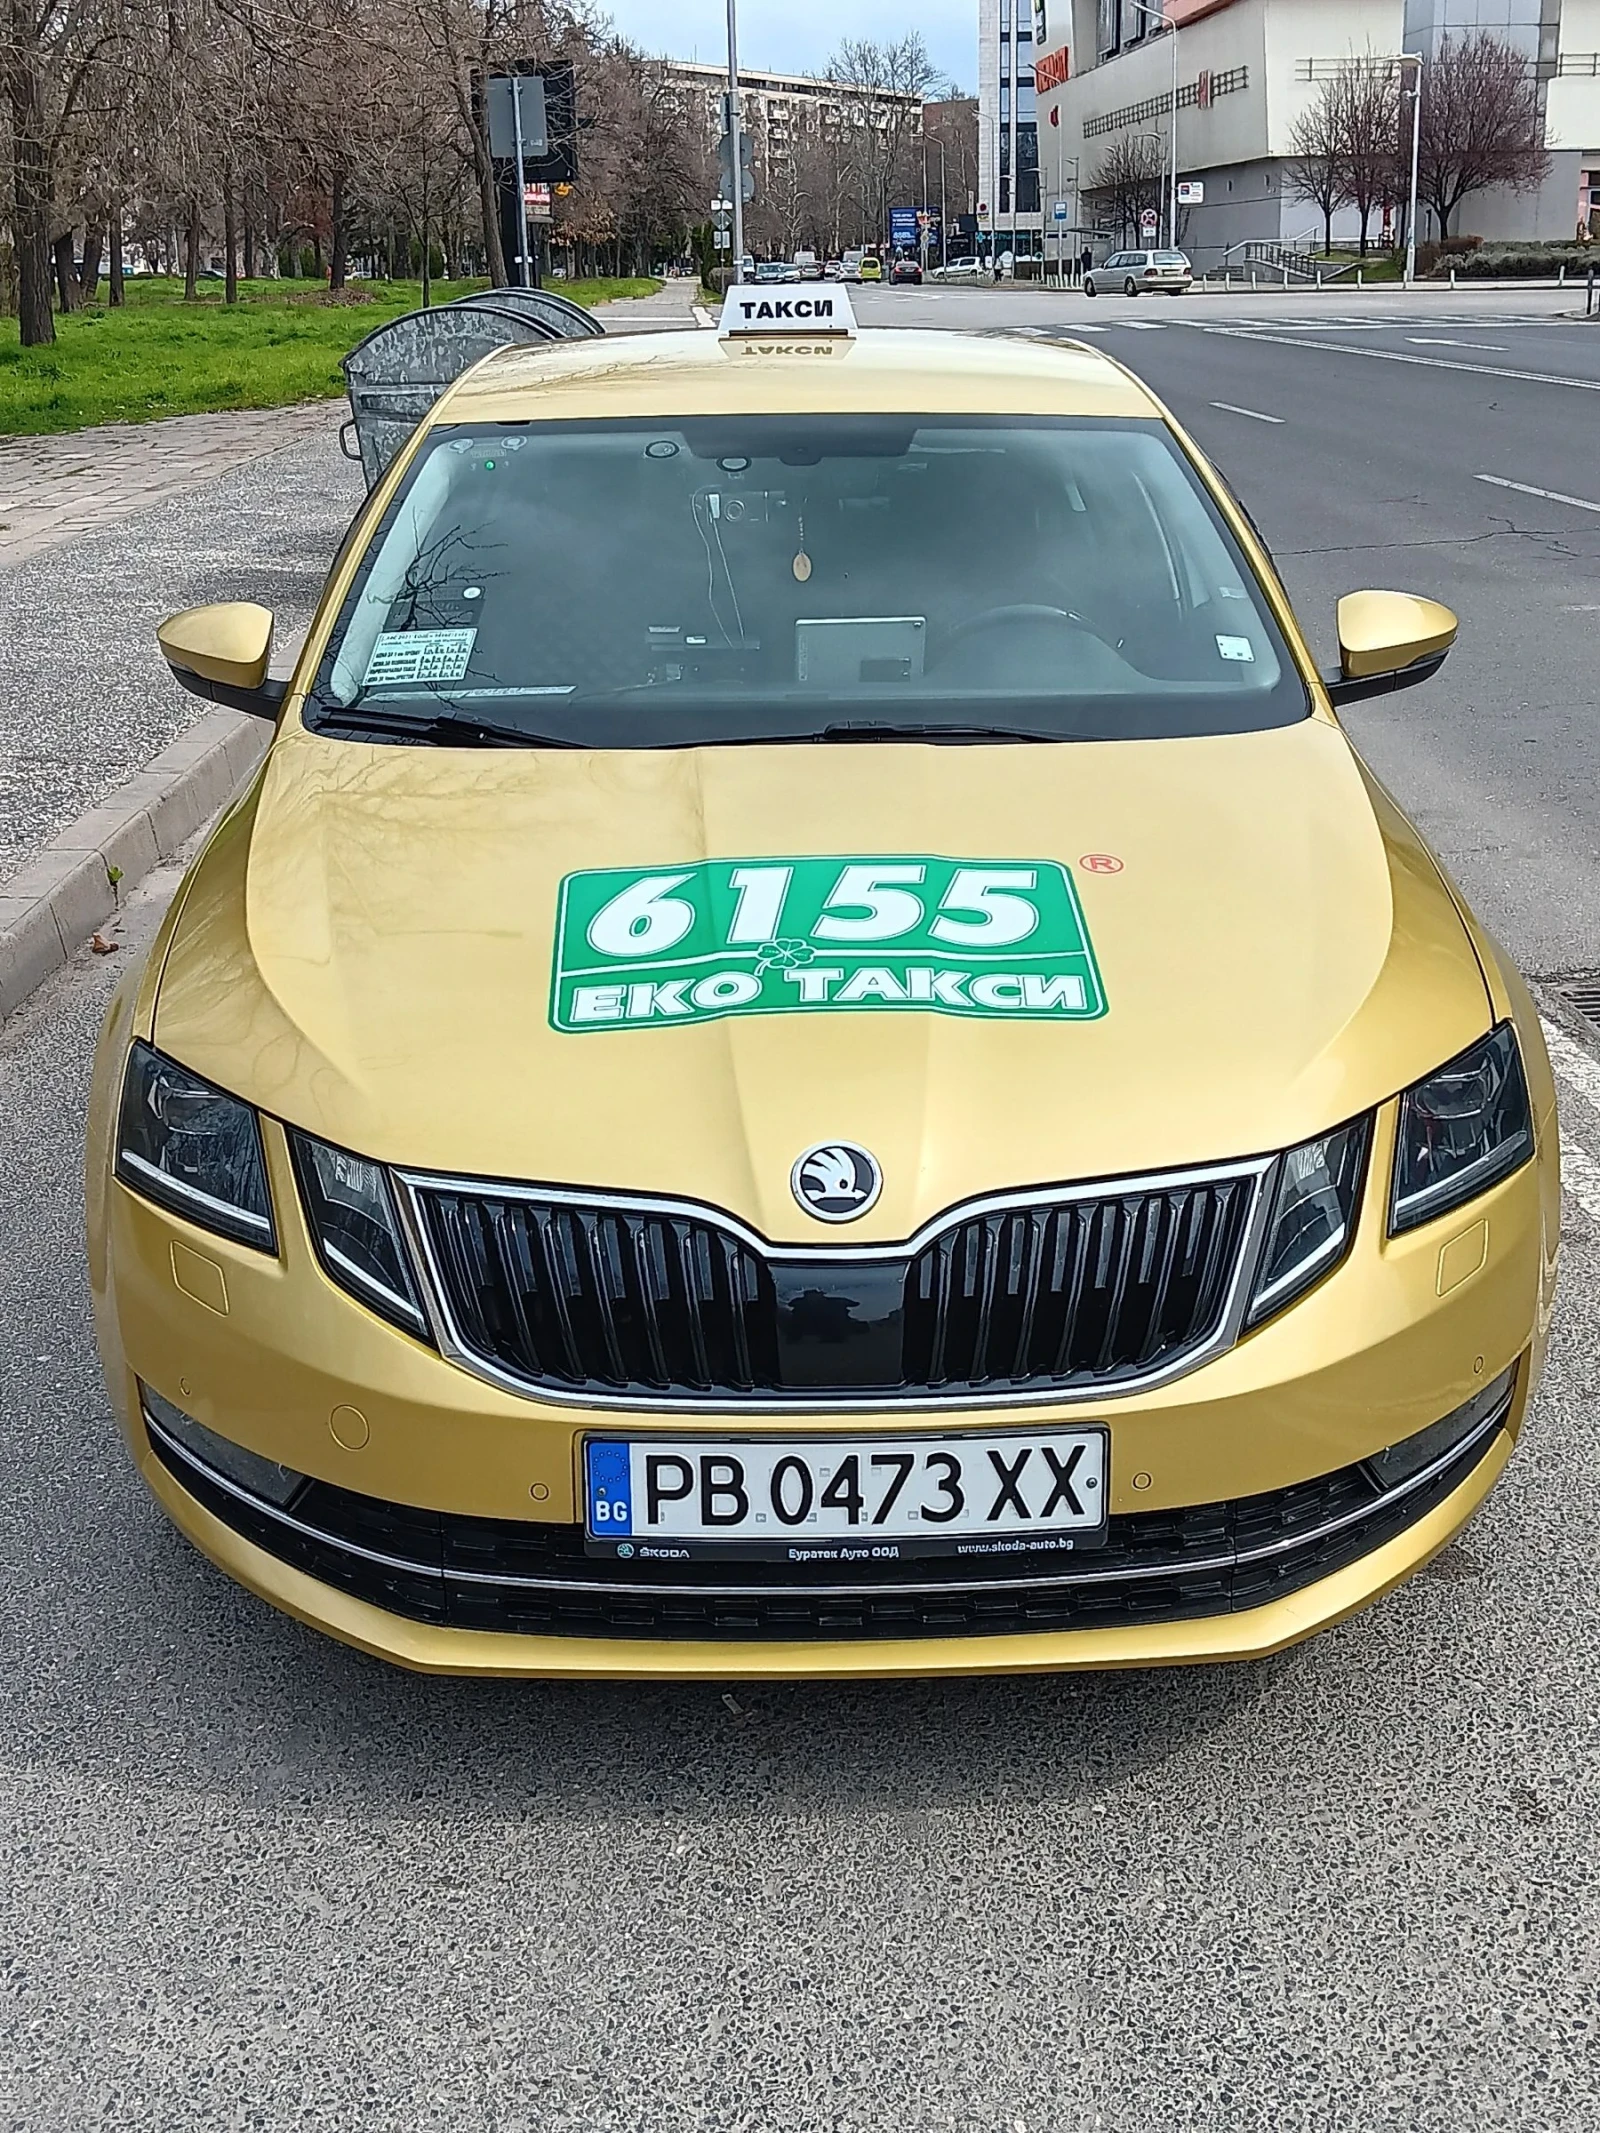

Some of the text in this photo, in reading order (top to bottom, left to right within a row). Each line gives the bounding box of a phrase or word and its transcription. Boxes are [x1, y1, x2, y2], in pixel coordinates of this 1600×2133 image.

[739, 300, 833, 319] ТАКСИ
[586, 864, 1039, 957] 6155
[568, 967, 1089, 1023] ЕКО ТАКСИ
[645, 1444, 1087, 1526] PB 0473 XX
[595, 1501, 628, 1522] BG
[640, 1546, 690, 1559] ŠKODA
[840, 1547, 869, 1561] Ауто
[871, 1546, 899, 1558] ООД
[957, 1537, 1074, 1554] www.skoda-auto.bg
